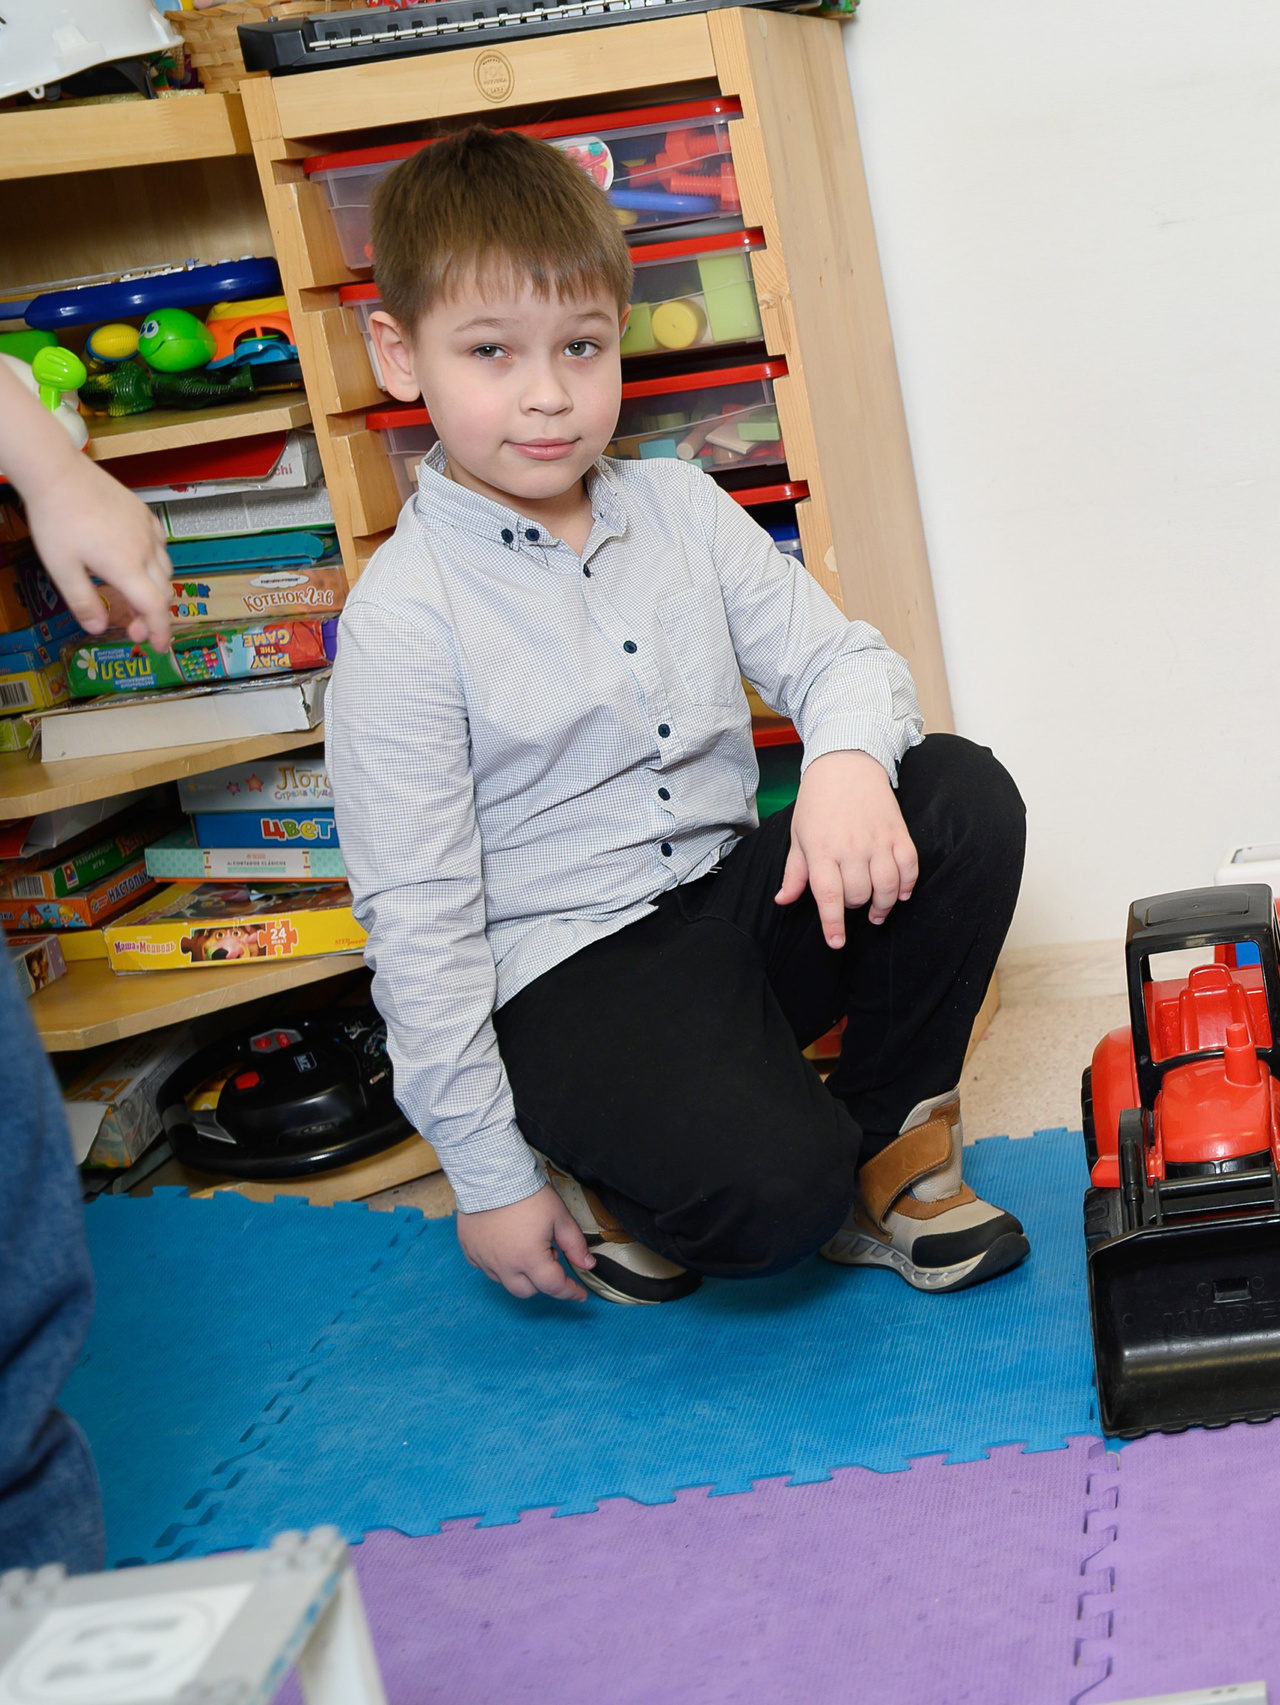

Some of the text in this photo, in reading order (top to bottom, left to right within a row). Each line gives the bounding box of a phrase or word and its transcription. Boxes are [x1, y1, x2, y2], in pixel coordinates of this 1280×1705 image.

[172, 582, 211, 598] ТИК
[170, 602, 208, 617] ТОЛЕ
[242, 628, 290, 647] GAME
[260, 645, 276, 654] THE
[250, 652, 292, 669] PLAY
[101, 658, 151, 680] ПАЗЛ
[107, 866, 152, 903] НАСТОЛЬН
[270, 927, 287, 940] 24
[114, 941, 136, 954] Маша
